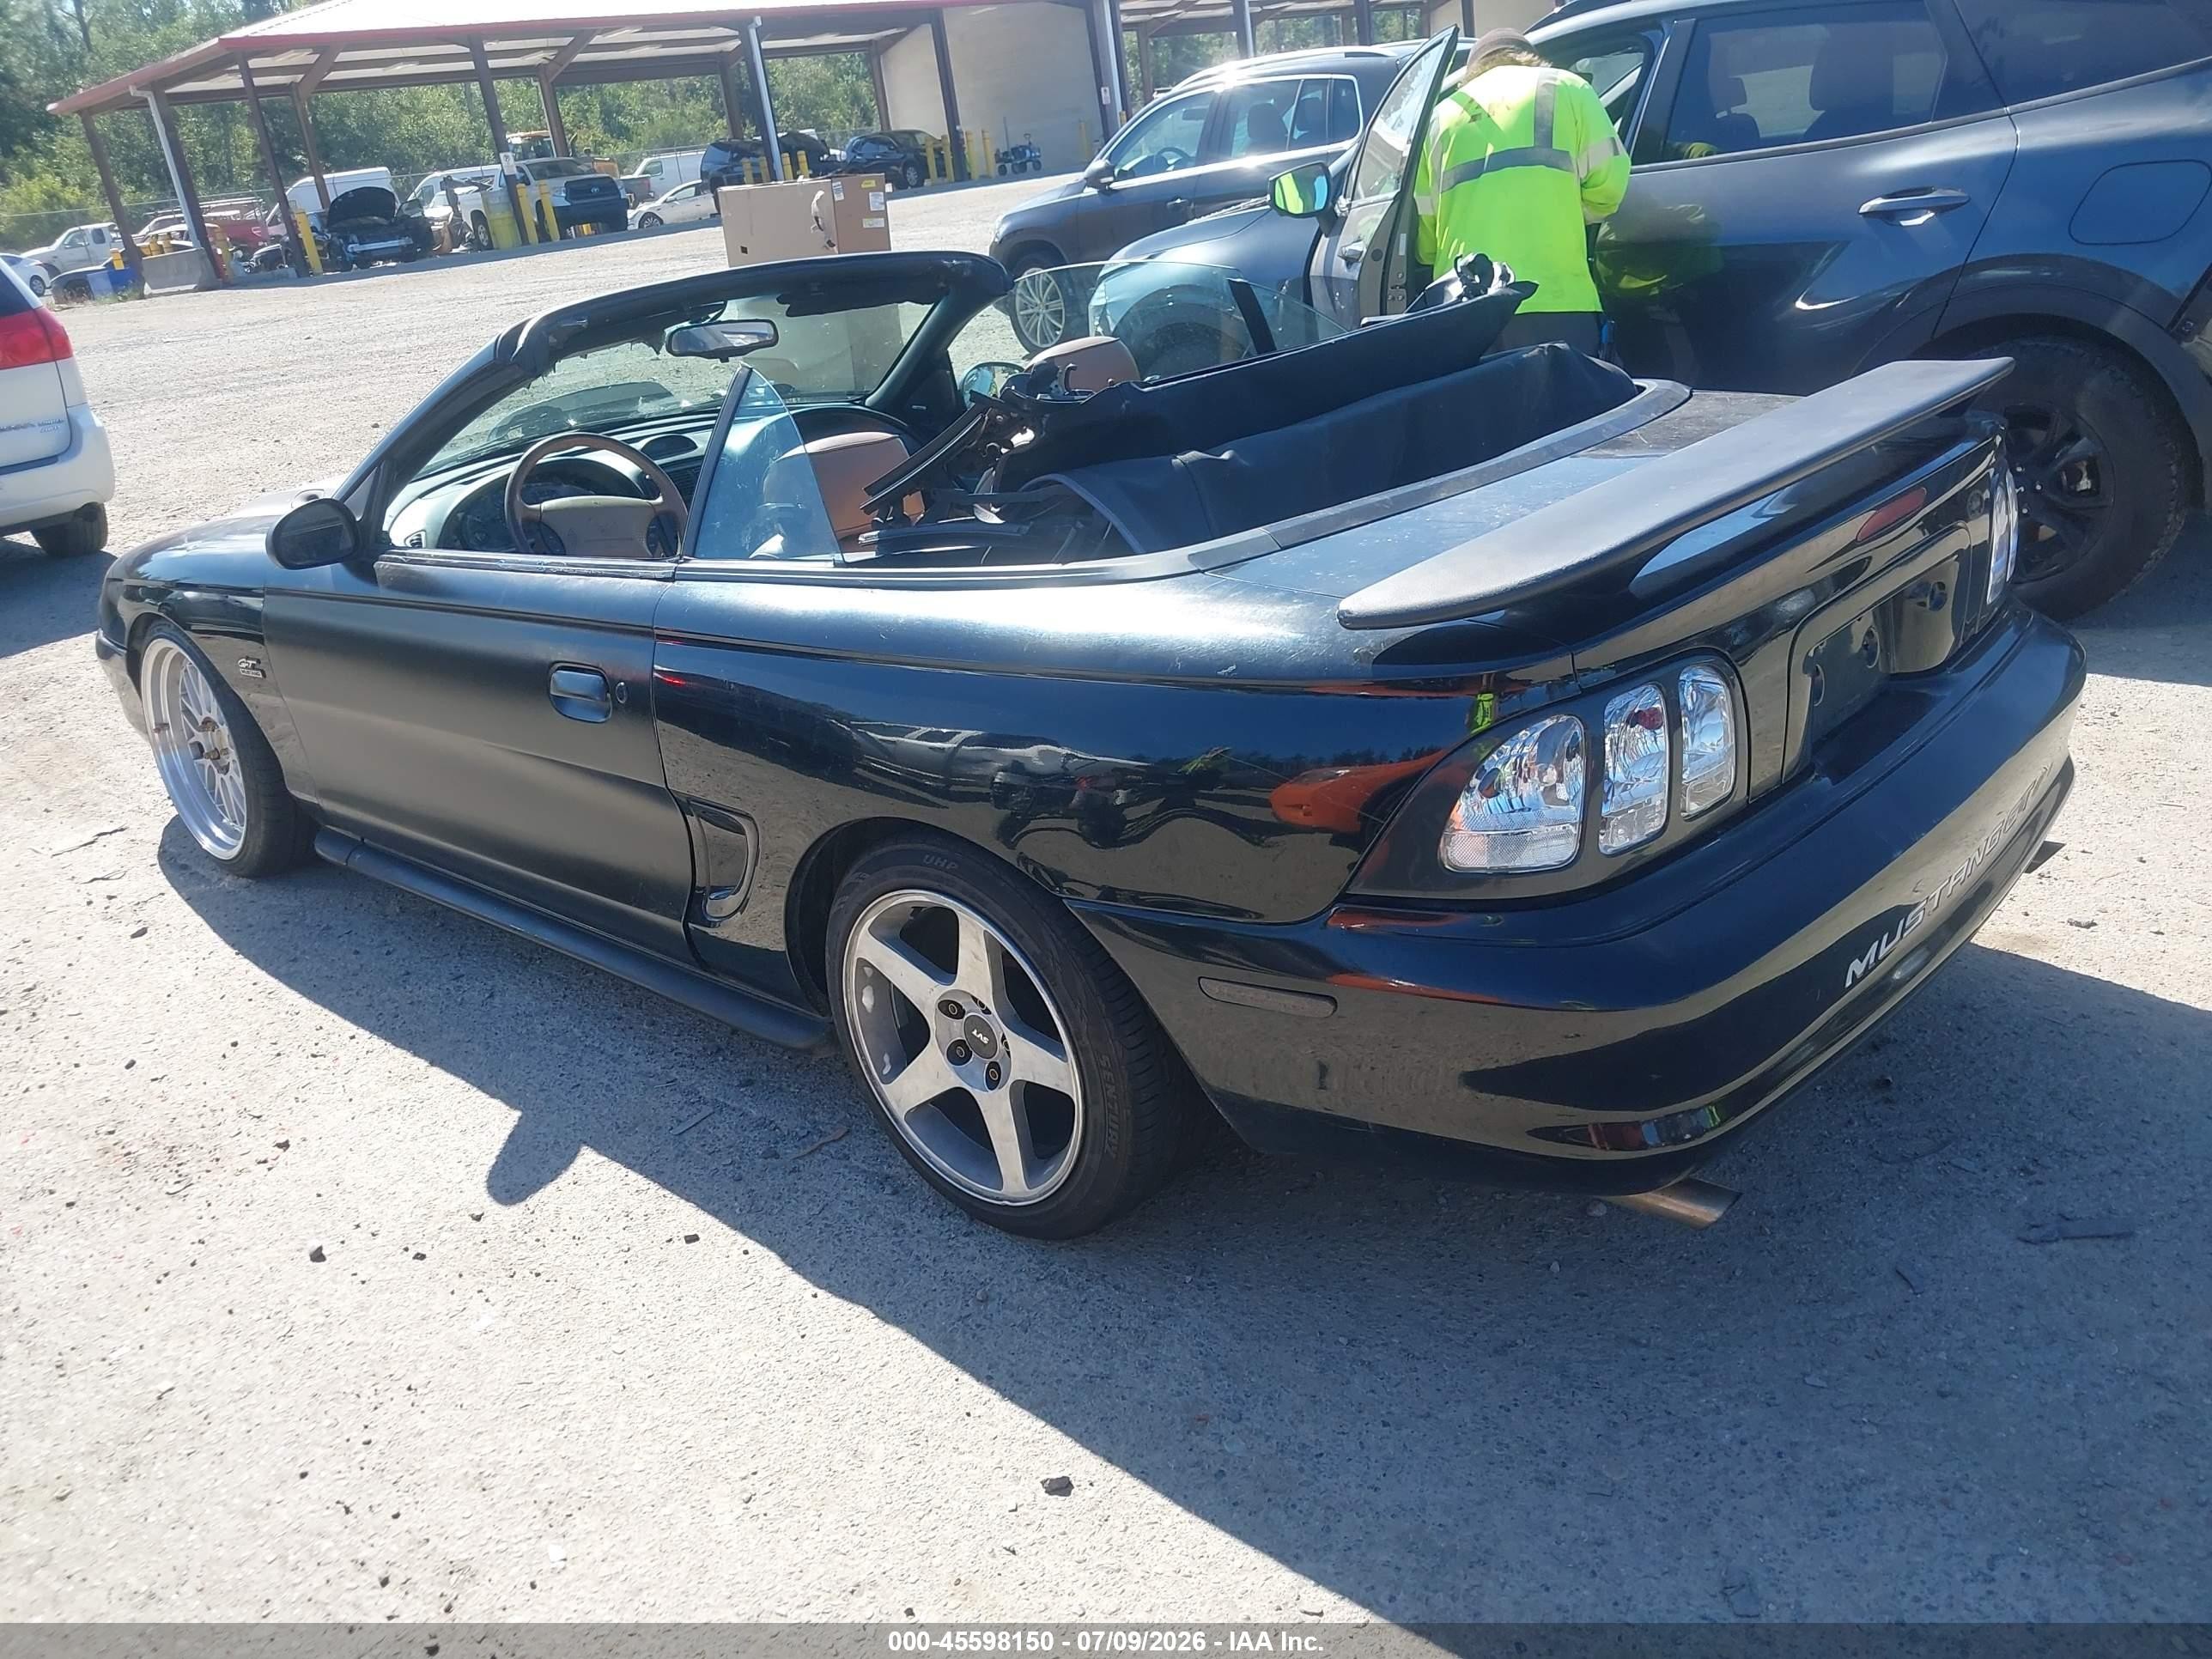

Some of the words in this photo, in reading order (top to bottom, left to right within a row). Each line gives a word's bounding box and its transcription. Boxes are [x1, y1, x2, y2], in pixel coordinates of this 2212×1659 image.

[238, 658, 257, 669] GT
[922, 854, 959, 870] UHP
[971, 1029, 990, 1044] SVT
